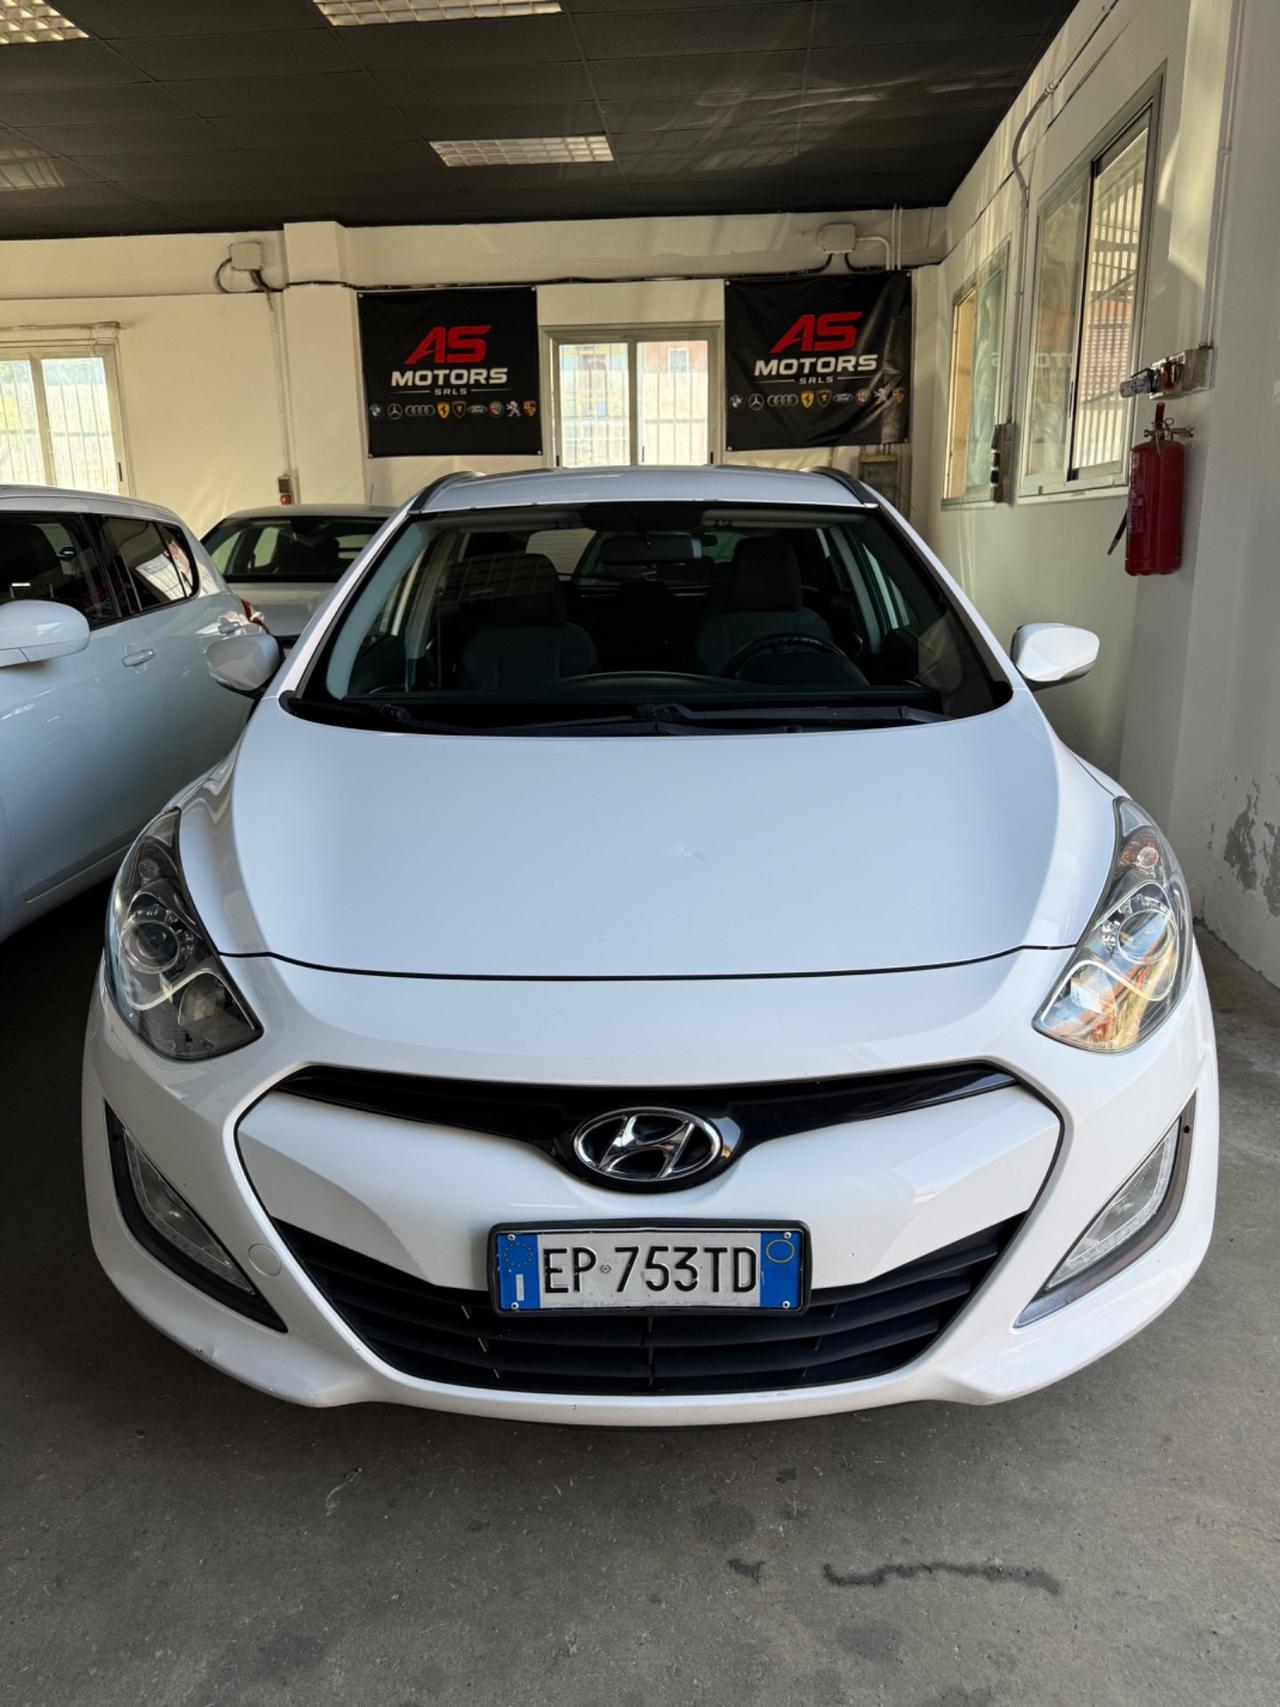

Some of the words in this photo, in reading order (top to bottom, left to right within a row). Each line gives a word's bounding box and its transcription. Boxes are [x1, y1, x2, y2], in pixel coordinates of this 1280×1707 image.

[769, 311, 864, 353] AS
[403, 325, 492, 365] AS
[755, 354, 878, 376] MOTORS
[391, 368, 508, 387] MOTORS
[799, 376, 833, 385] SRLS
[434, 388, 467, 396] SRLS
[543, 1246, 597, 1293] EP
[614, 1245, 757, 1293] 753TD
